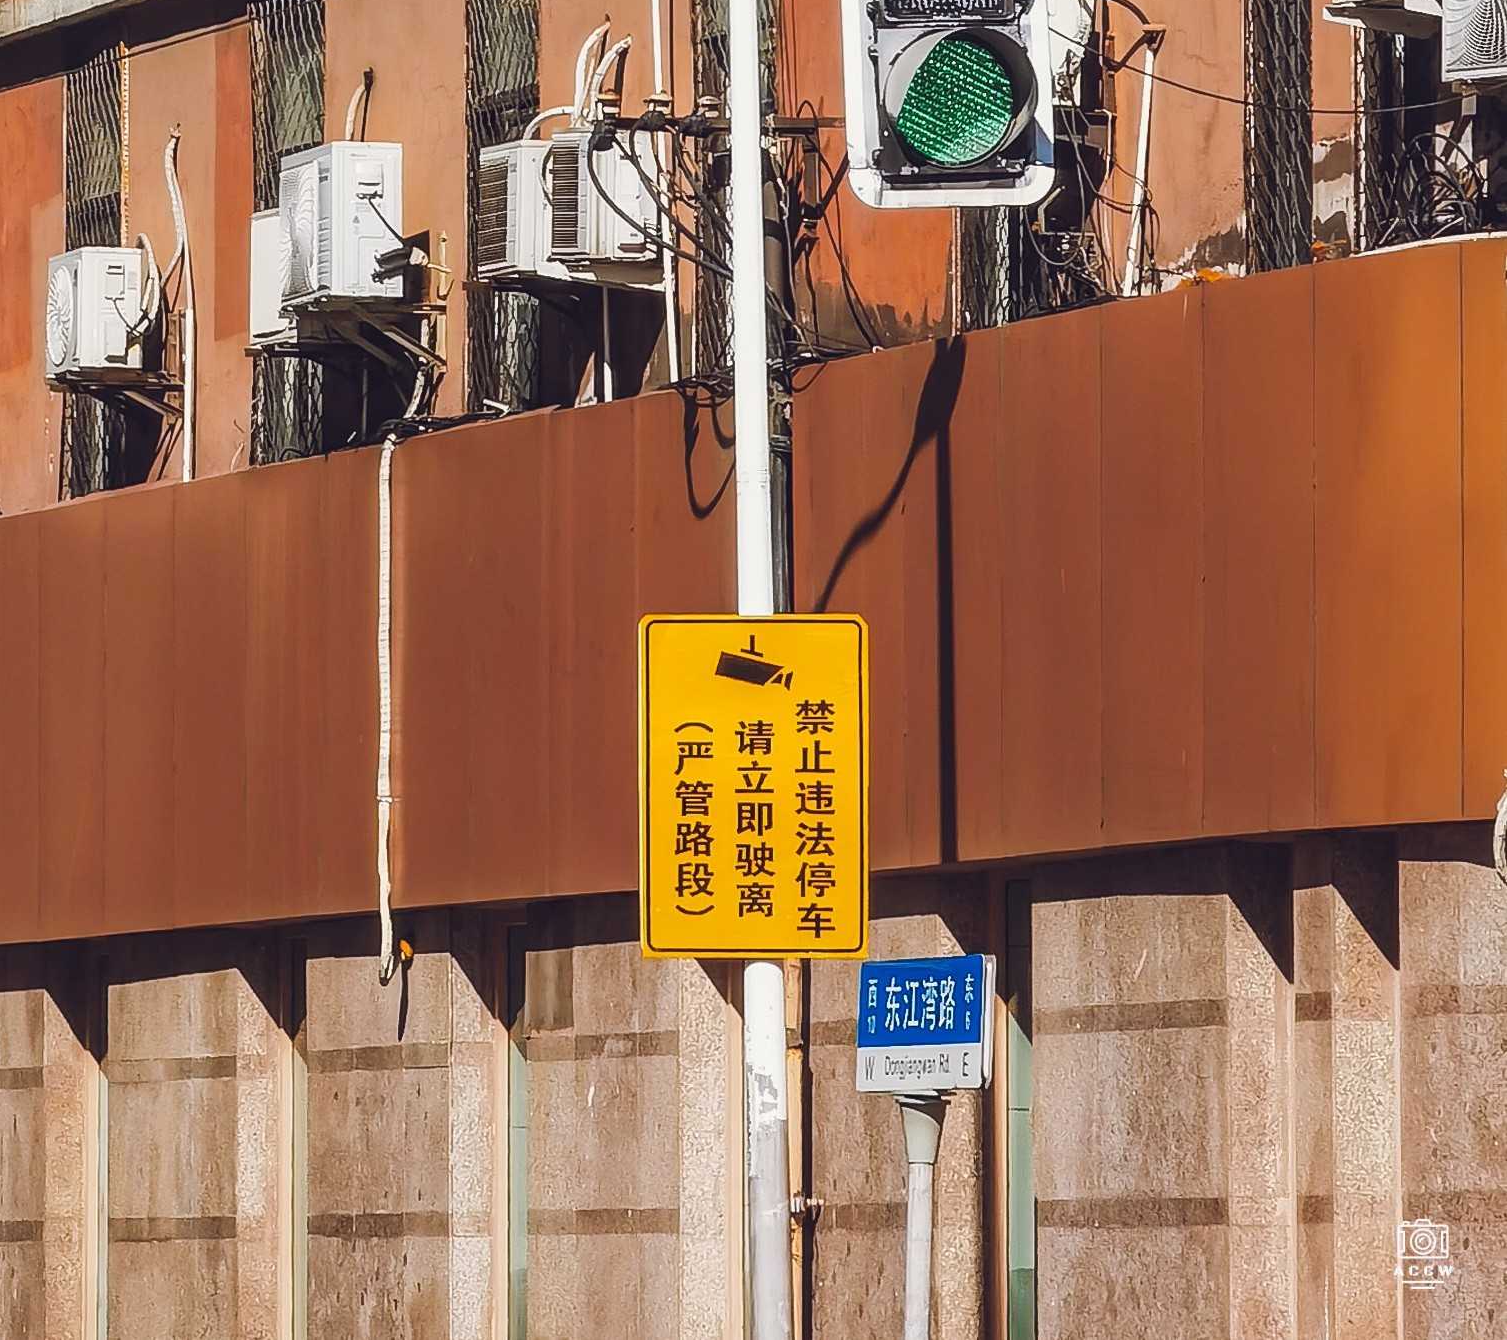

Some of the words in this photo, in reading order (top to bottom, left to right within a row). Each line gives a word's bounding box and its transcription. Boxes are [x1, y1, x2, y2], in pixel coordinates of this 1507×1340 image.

[734, 720, 776, 918] 请立即驶离
[795, 699, 836, 938] 禁止违法停车
[868, 979, 877, 1008] 西
[885, 975, 956, 1031] 东江湾路
[961, 1051, 970, 1077] E
